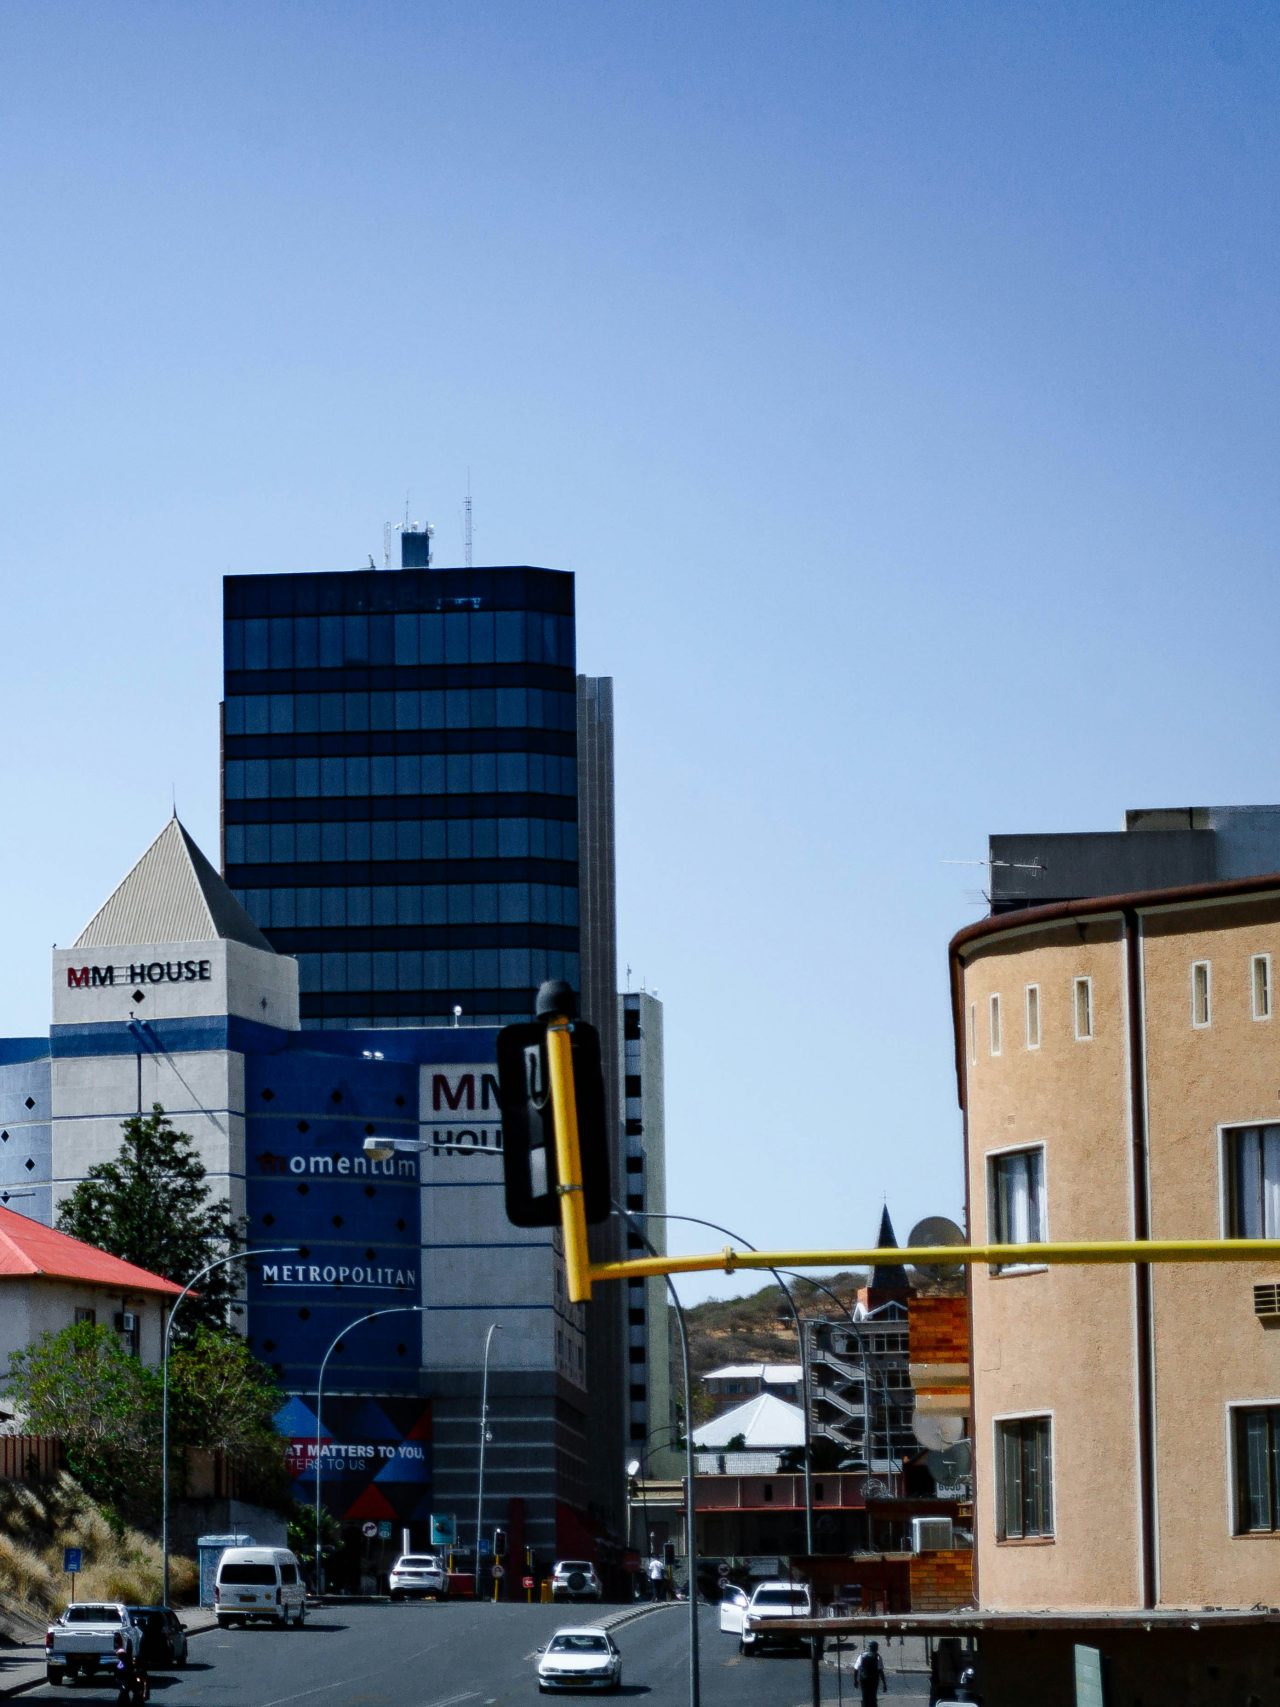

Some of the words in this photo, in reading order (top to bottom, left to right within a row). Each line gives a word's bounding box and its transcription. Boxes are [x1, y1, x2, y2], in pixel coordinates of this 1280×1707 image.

[67, 965, 114, 988] MM
[129, 959, 211, 984] HOUSE
[262, 1264, 416, 1286] METROPOLITAN
[307, 1444, 375, 1458] MATTERS
[377, 1445, 396, 1458] TO
[398, 1446, 425, 1462] YOU,
[327, 1458, 345, 1470] TO
